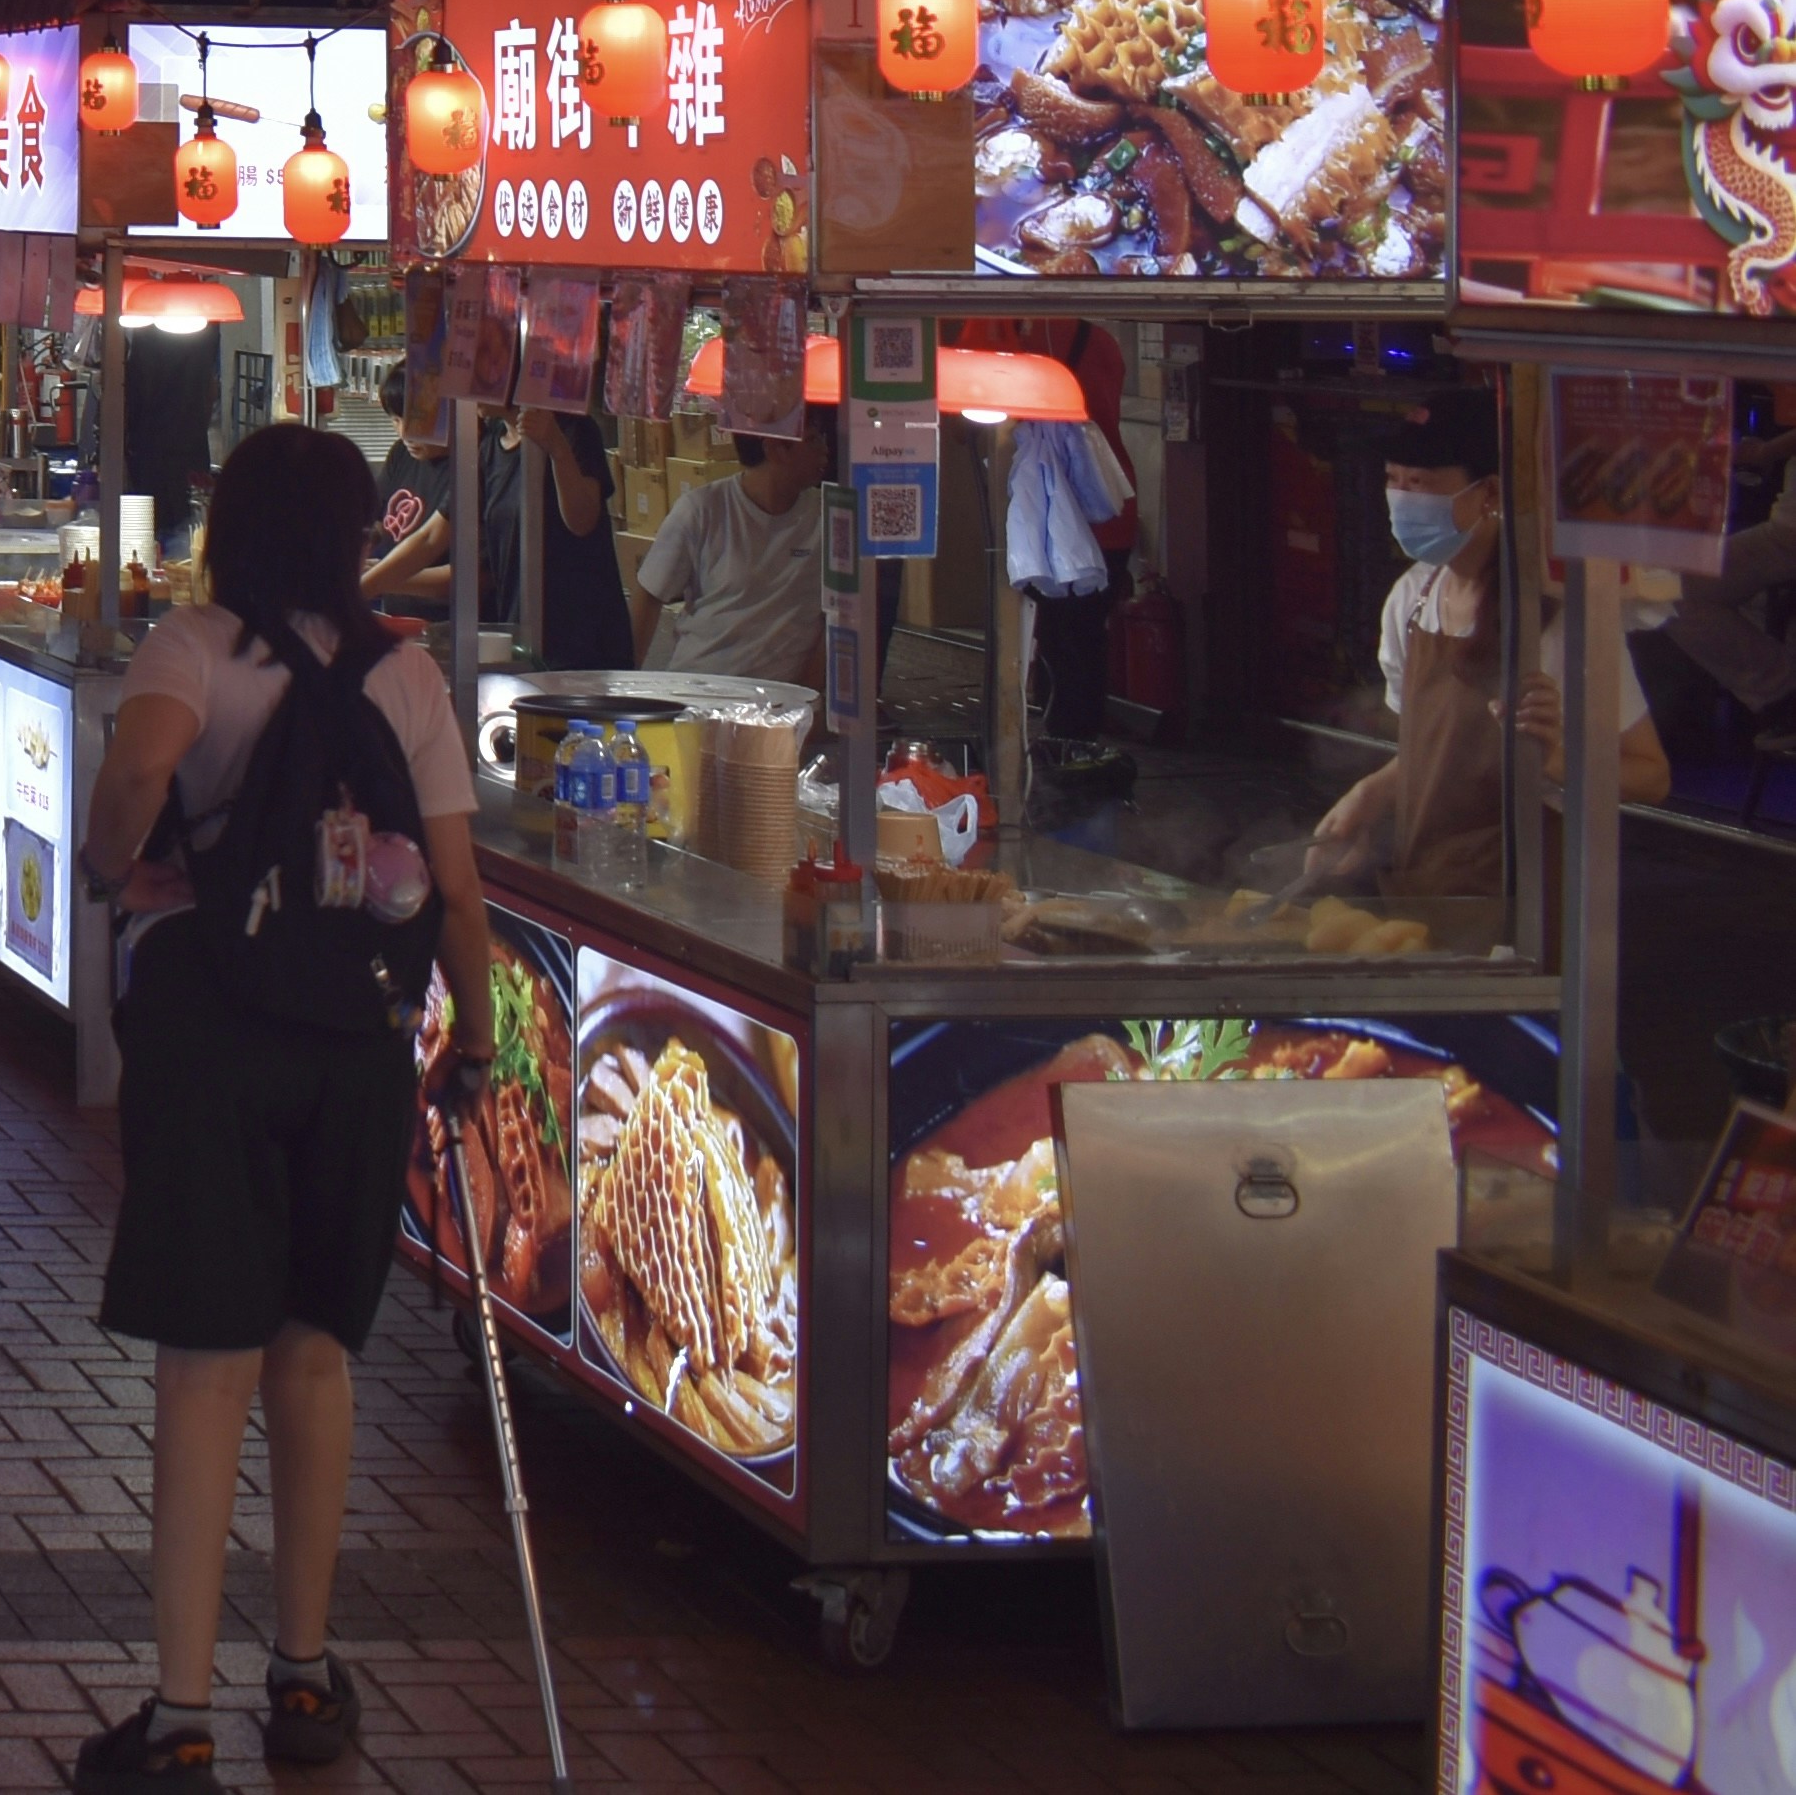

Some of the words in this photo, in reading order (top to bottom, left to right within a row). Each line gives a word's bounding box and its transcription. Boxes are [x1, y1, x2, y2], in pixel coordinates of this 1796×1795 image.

[890, 5, 946, 60] 福
[492, 0, 726, 150] 廟街雜
[183, 165, 218, 200] 福
